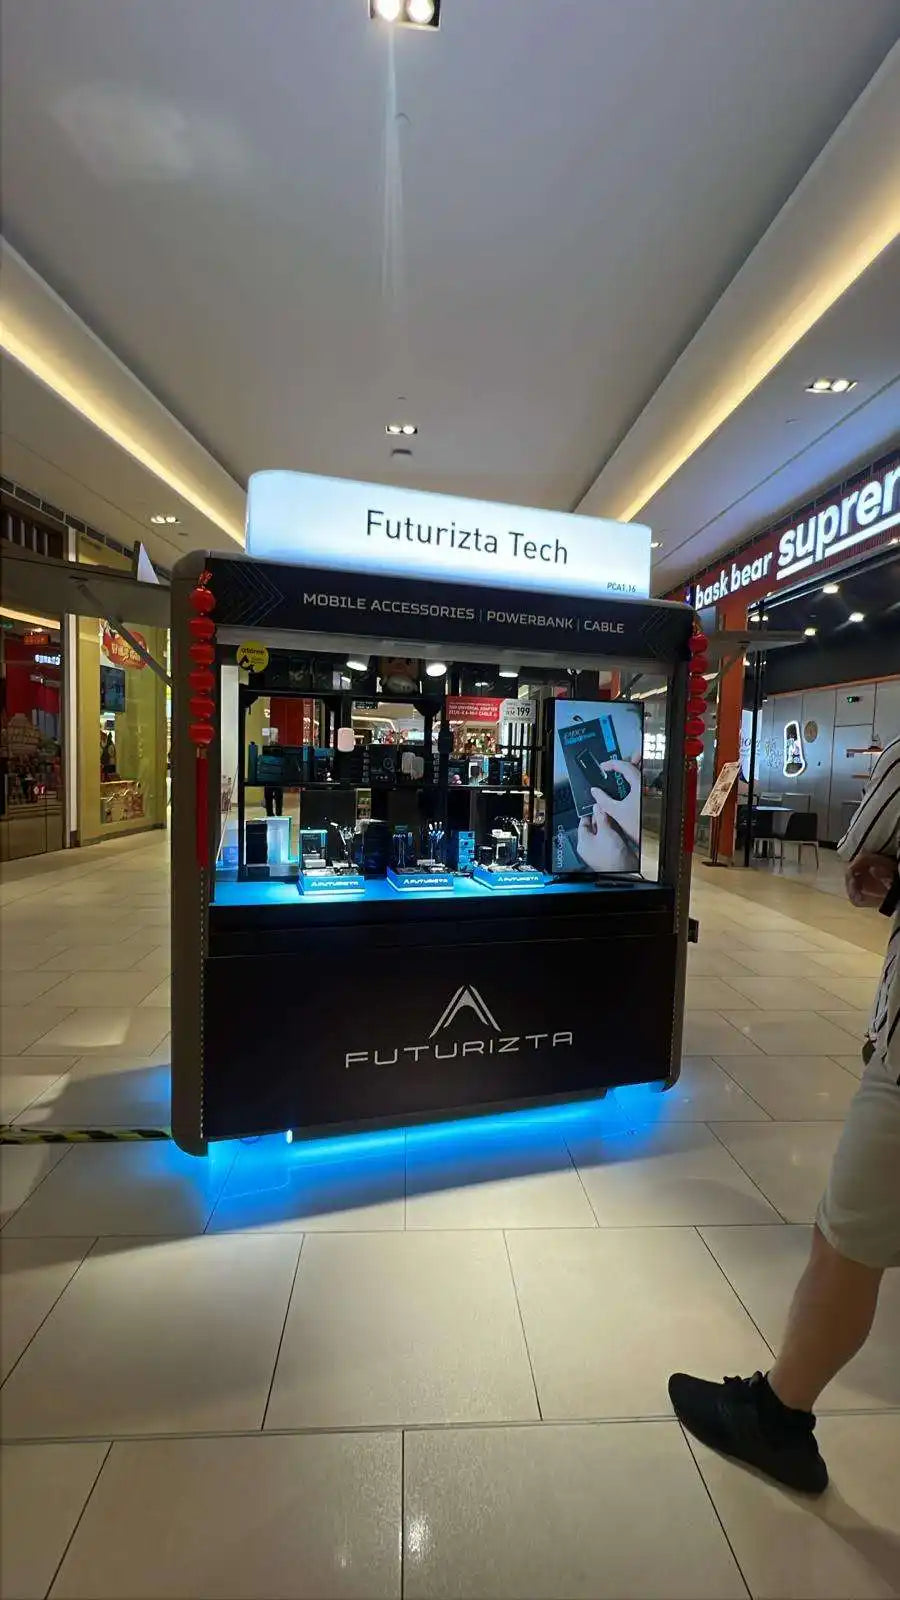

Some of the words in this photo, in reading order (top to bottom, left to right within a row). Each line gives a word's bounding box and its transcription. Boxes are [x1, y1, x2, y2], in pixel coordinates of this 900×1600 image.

[366, 509, 499, 555] Futurizta
[508, 531, 569, 565] Tech
[606, 582, 637, 593] PCA1.16
[695, 571, 729, 610] bask
[730, 551, 773, 592] bear
[303, 592, 367, 611] MOBILE
[370, 599, 475, 620] ACCESSORIES
[487, 610, 573, 630] POWERBANK
[584, 620, 625, 634] CABLE
[517, 706, 531, 717] 199
[345, 1031, 573, 1069] FUTURIZTA
